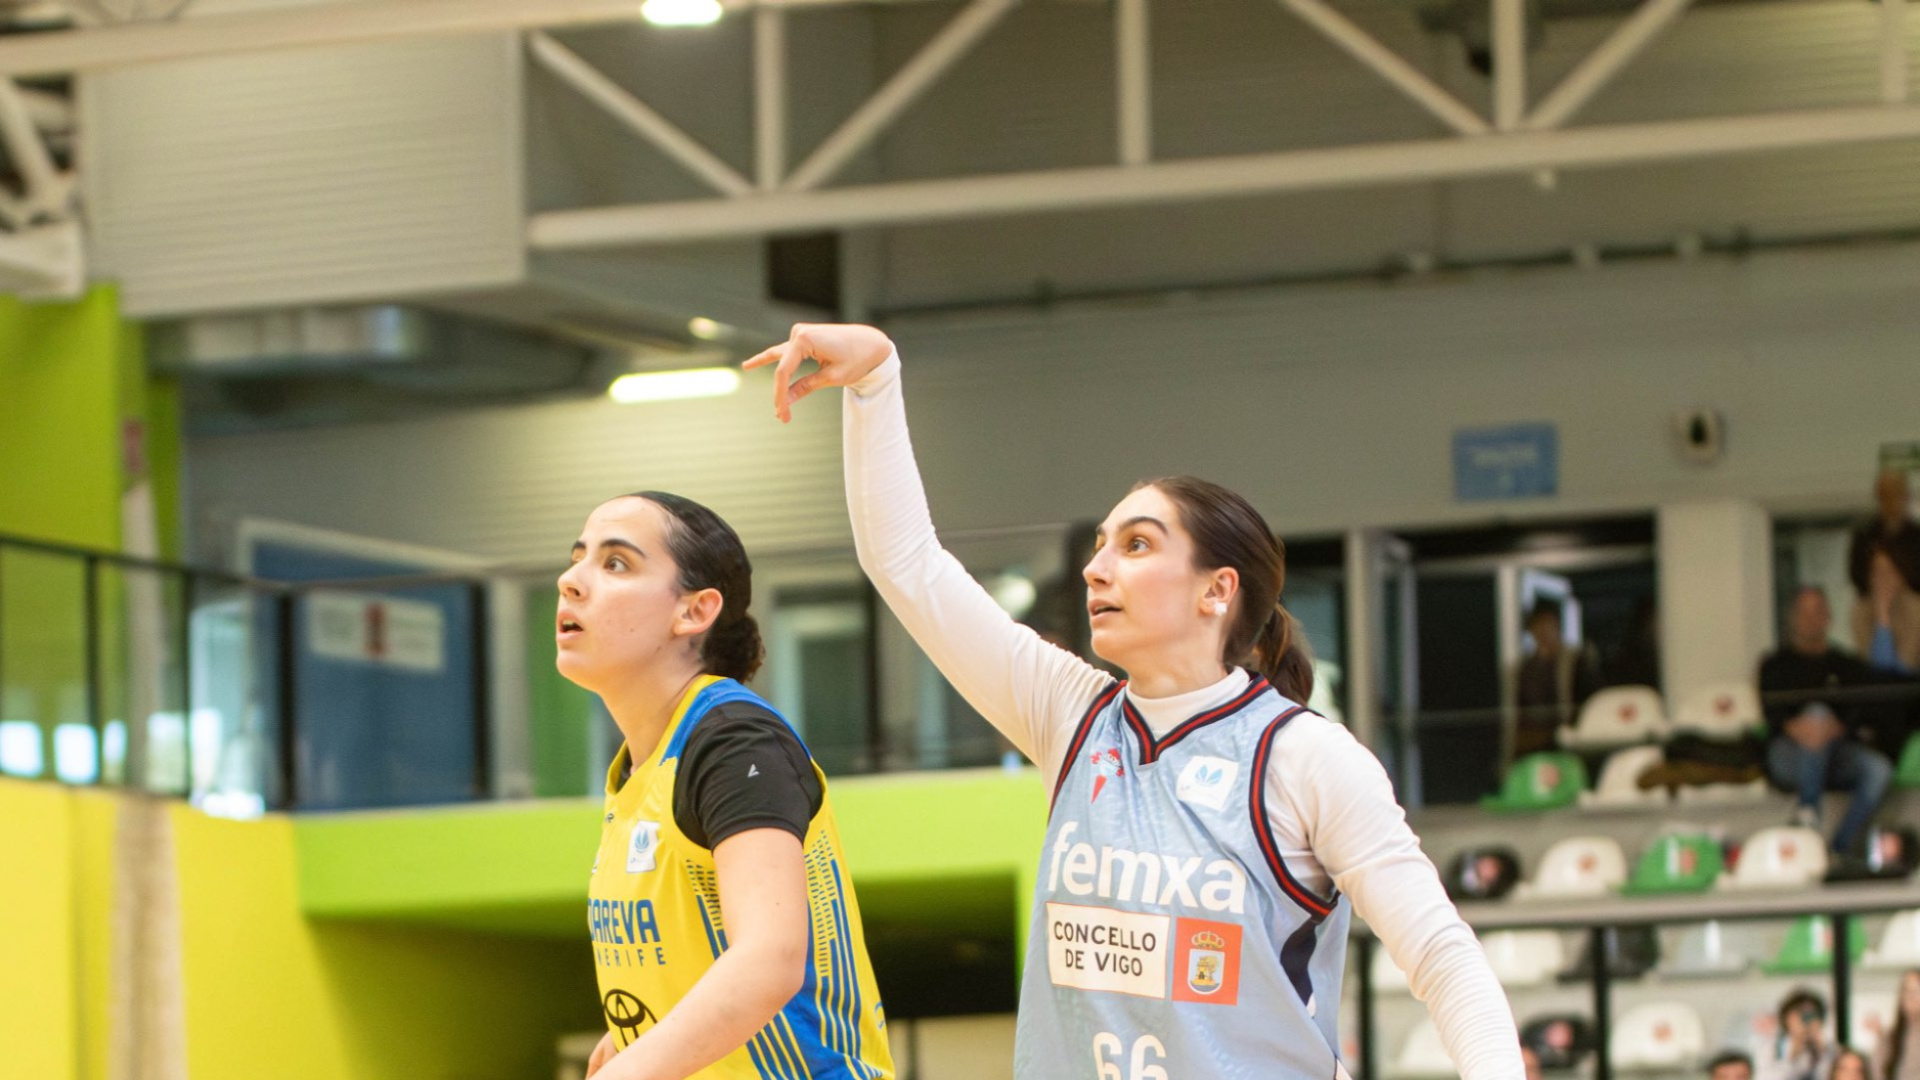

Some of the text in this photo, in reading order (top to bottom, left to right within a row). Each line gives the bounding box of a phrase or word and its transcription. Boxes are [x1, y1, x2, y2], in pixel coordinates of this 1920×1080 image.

[1048, 821, 1247, 915] femxa
[1054, 921, 1156, 952] CONCELLO
[1065, 949, 1143, 977] DE VIGO
[1093, 1031, 1168, 1080] 66
